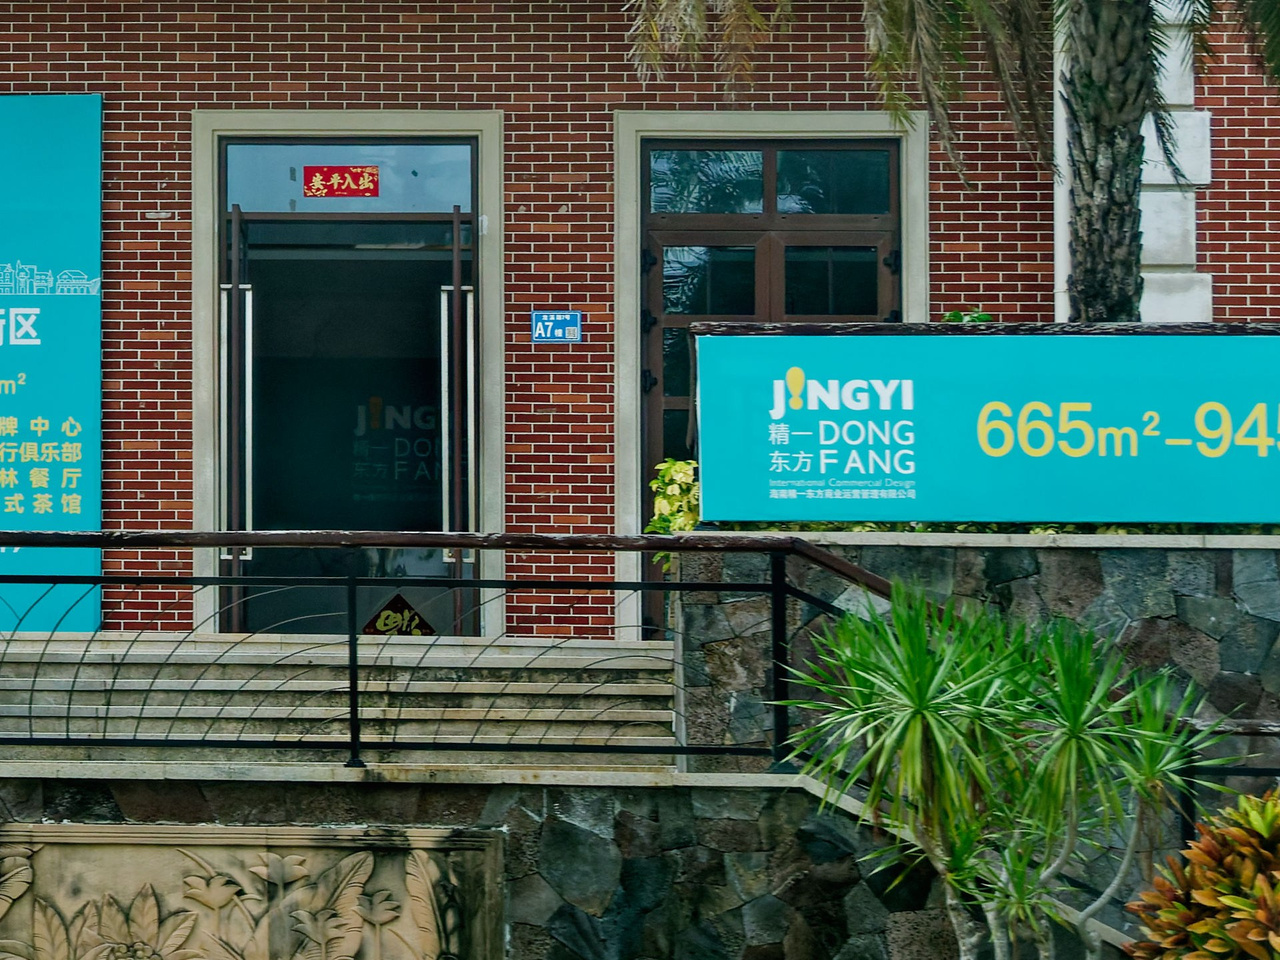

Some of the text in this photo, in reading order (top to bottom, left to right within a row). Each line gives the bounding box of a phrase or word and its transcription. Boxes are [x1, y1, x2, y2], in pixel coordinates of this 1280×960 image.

[535, 322, 553, 338] A7
[768, 420, 915, 445] 精一 DONG
[977, 401, 1280, 458] 665m²-94
[768, 449, 916, 474] 东方 FANG
